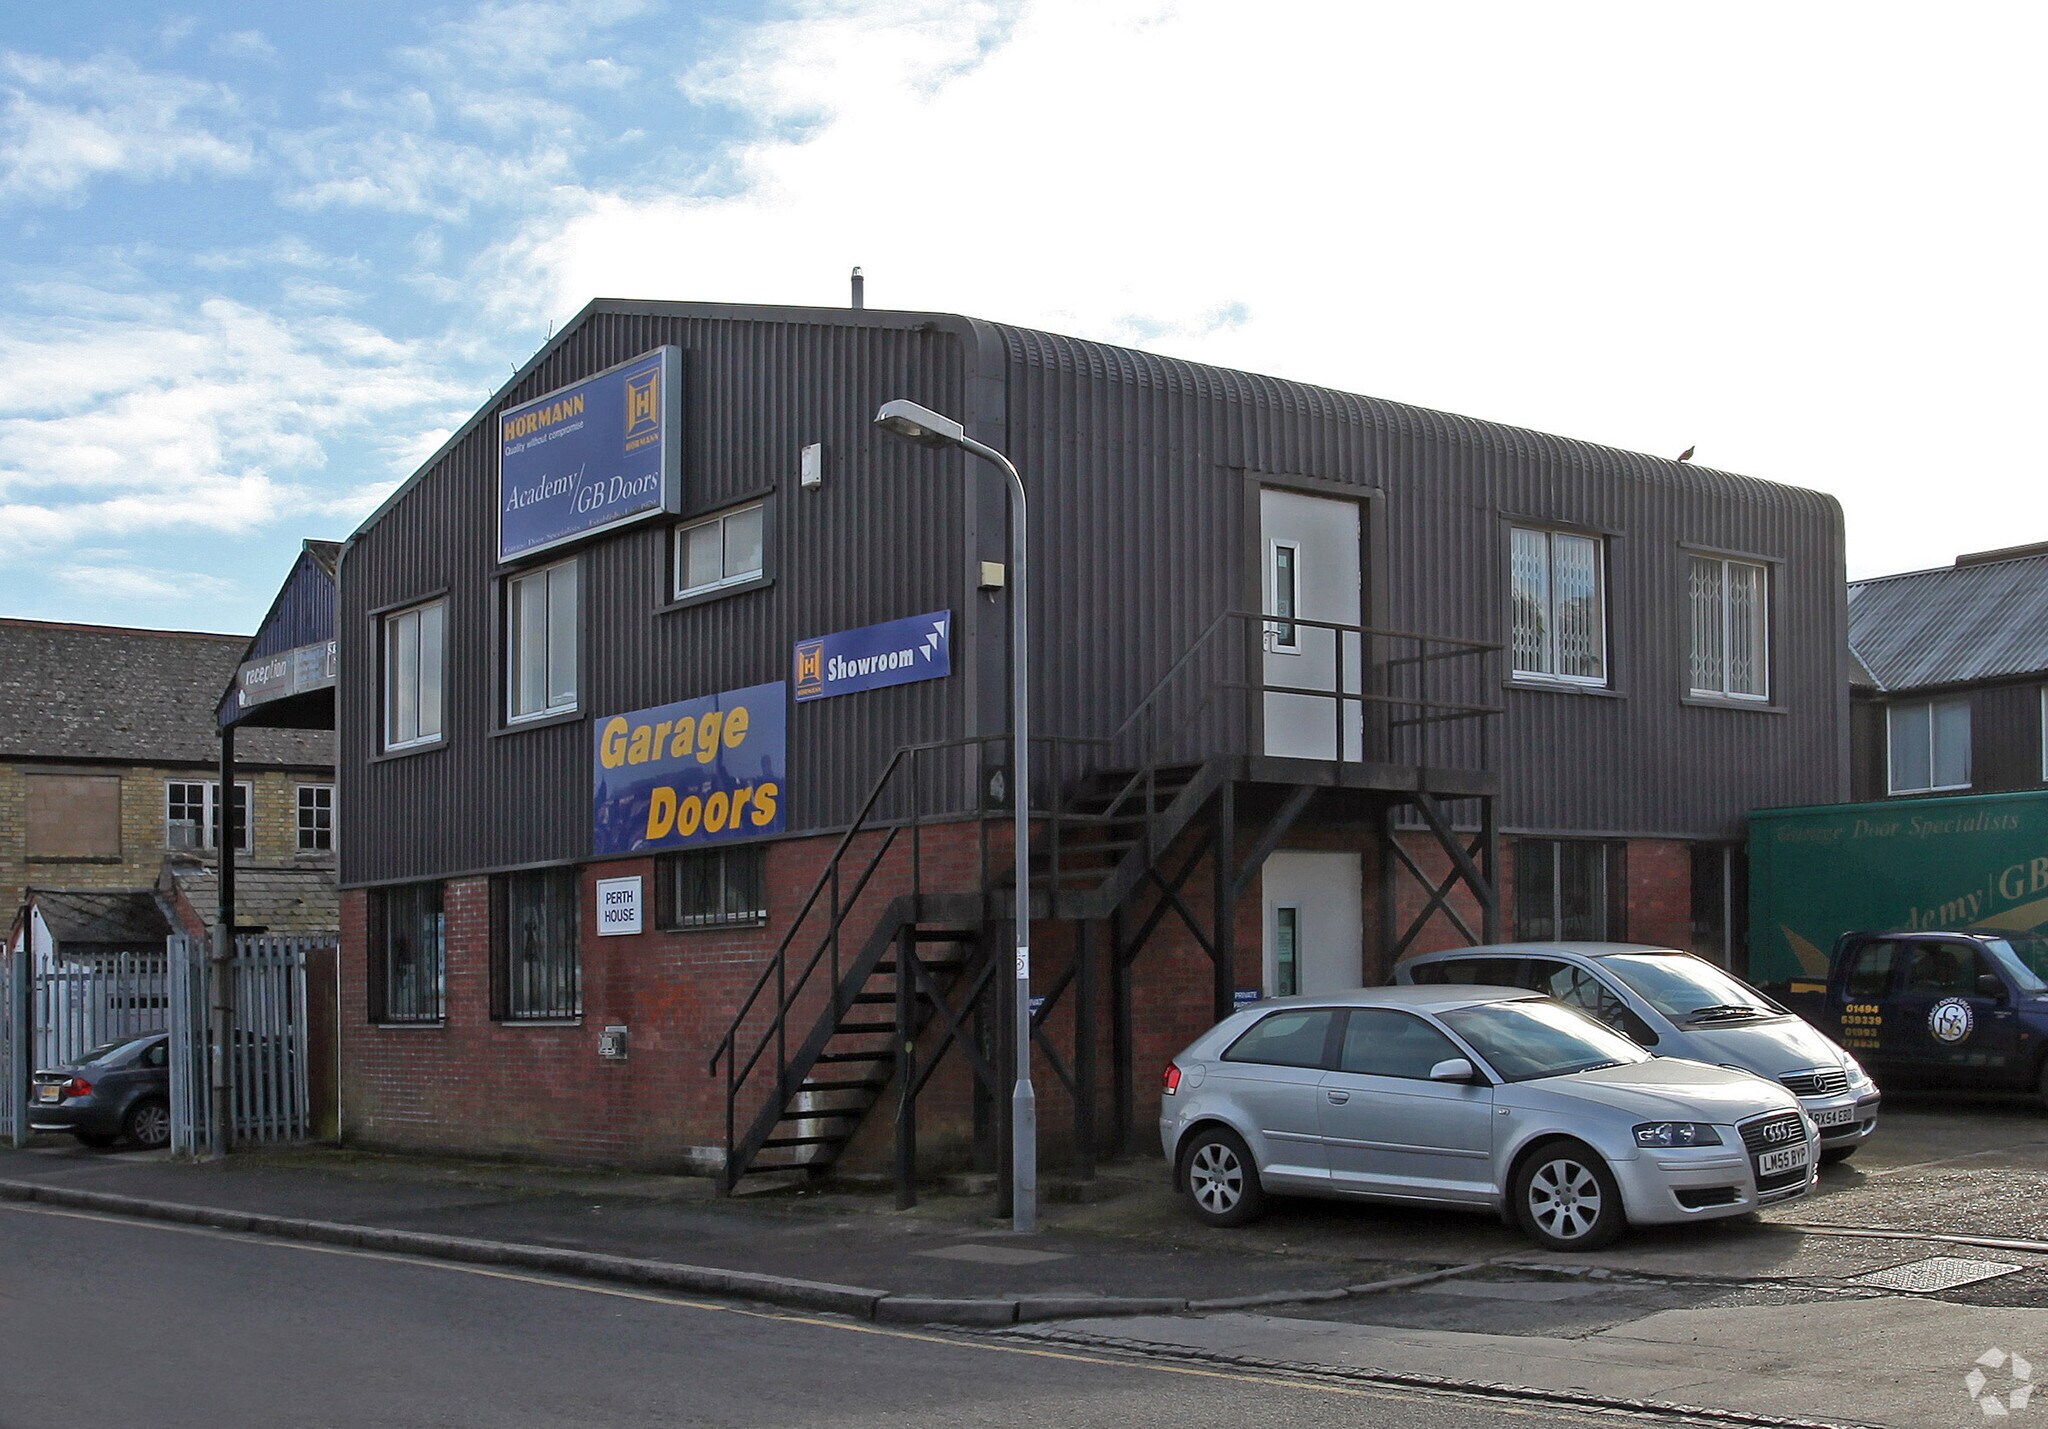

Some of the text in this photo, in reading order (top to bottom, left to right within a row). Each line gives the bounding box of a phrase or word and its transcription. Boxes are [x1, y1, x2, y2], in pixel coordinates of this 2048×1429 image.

[505, 421, 584, 456] Quality without compromise
[246, 659, 287, 685] reception
[828, 648, 914, 682] Showroom
[600, 706, 749, 769] Garage
[645, 782, 778, 840] Doors
[1908, 811, 2019, 839] Specialists
[606, 890, 633, 904] PERTH
[605, 908, 635, 923] HOUSE
[1234, 991, 1257, 999] PRIVATE
[1763, 1147, 1806, 1171] LM55 BYP
